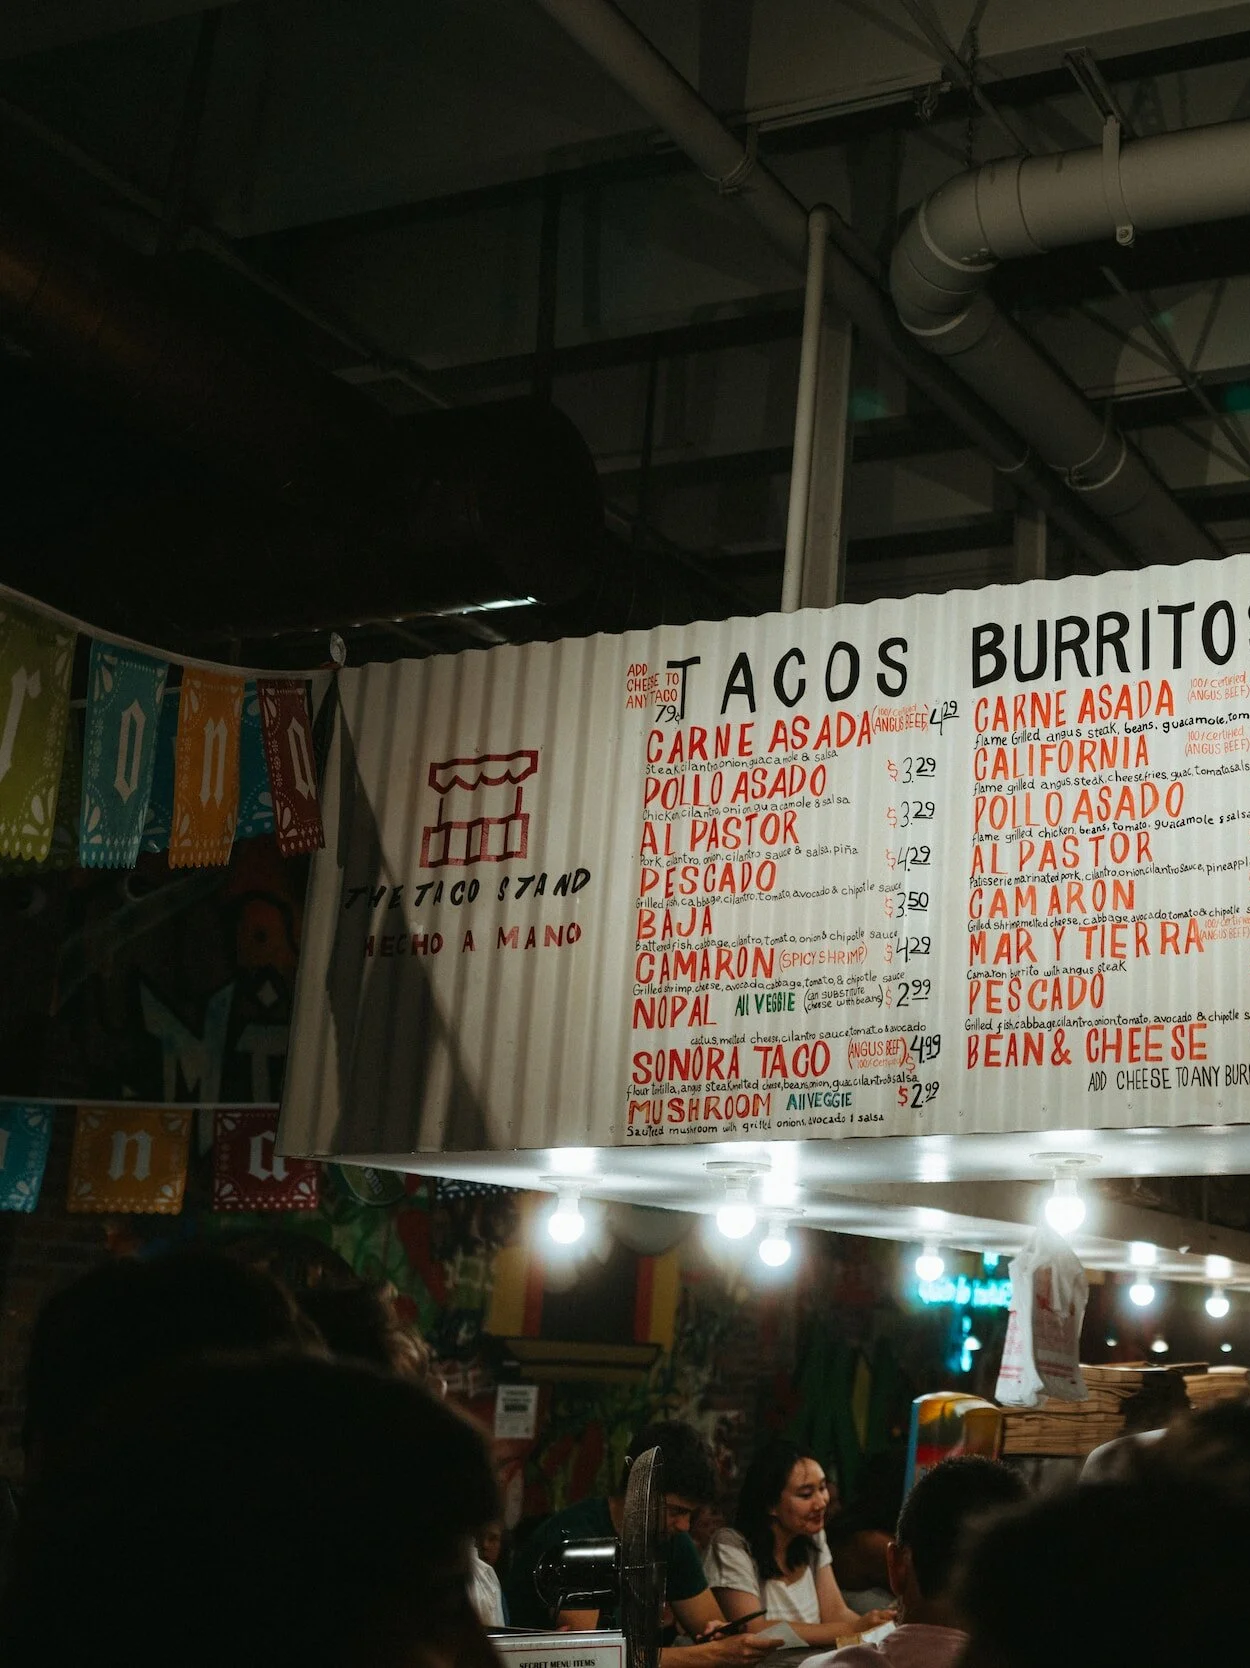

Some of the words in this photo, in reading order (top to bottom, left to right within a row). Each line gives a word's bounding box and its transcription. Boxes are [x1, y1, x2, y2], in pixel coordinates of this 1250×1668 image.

[627, 665, 647, 676] ADD
[627, 674, 659, 692] CHEESE
[666, 673, 680, 686] TO
[667, 638, 907, 719] TACOS
[626, 694, 647, 709] ANY
[651, 690, 678, 703] TACO
[974, 690, 1067, 733] CARNE
[1078, 680, 1175, 724] ASADA
[647, 722, 754, 763] CARNE
[768, 710, 872, 753] ASADA
[1047, 728, 1082, 743] angus
[974, 735, 1149, 782] CALIFORNIA
[644, 771, 723, 810] POLLO
[732, 765, 826, 804] ASADO
[975, 792, 1063, 832] POLLO
[1072, 782, 1184, 825] ASADO
[641, 821, 675, 856] AL
[690, 810, 799, 852] PASTOR
[1155, 814, 1214, 830] guacamole
[971, 844, 1009, 876] AL
[1019, 831, 1154, 872] PASTOR
[345, 885, 404, 909] THE
[414, 878, 480, 906] TACO
[498, 868, 590, 900] STAND
[641, 861, 777, 898] PESCADO
[969, 879, 1135, 920] CAMARON
[366, 932, 444, 957] HECHO
[462, 930, 475, 953] A
[497, 922, 581, 949] MANO
[637, 904, 713, 941] BAJA
[969, 925, 1038, 966] MAR
[1053, 925, 1066, 961] Y
[1079, 918, 1204, 961] TIERRA
[636, 947, 774, 984] CAMARON
[633, 994, 717, 1029] NOPAL
[756, 993, 795, 1013] VEGGIE
[969, 972, 1105, 1015] PESCADO
[633, 1045, 740, 1084] SONORA
[753, 1040, 830, 1079] TACO
[967, 1030, 1043, 1070] BEAN
[1051, 1028, 1072, 1067] &
[1086, 1023, 1207, 1064] CHEESE
[1088, 1072, 1107, 1092] ADD
[1117, 1069, 1172, 1090] CHEESE
[1176, 1067, 1191, 1087] TO
[1191, 1066, 1222, 1087] ANY
[629, 1093, 771, 1124] MUSHROOM
[806, 1092, 852, 1109] VEGGIE
[574, 1659, 595, 1667] ITEMS
